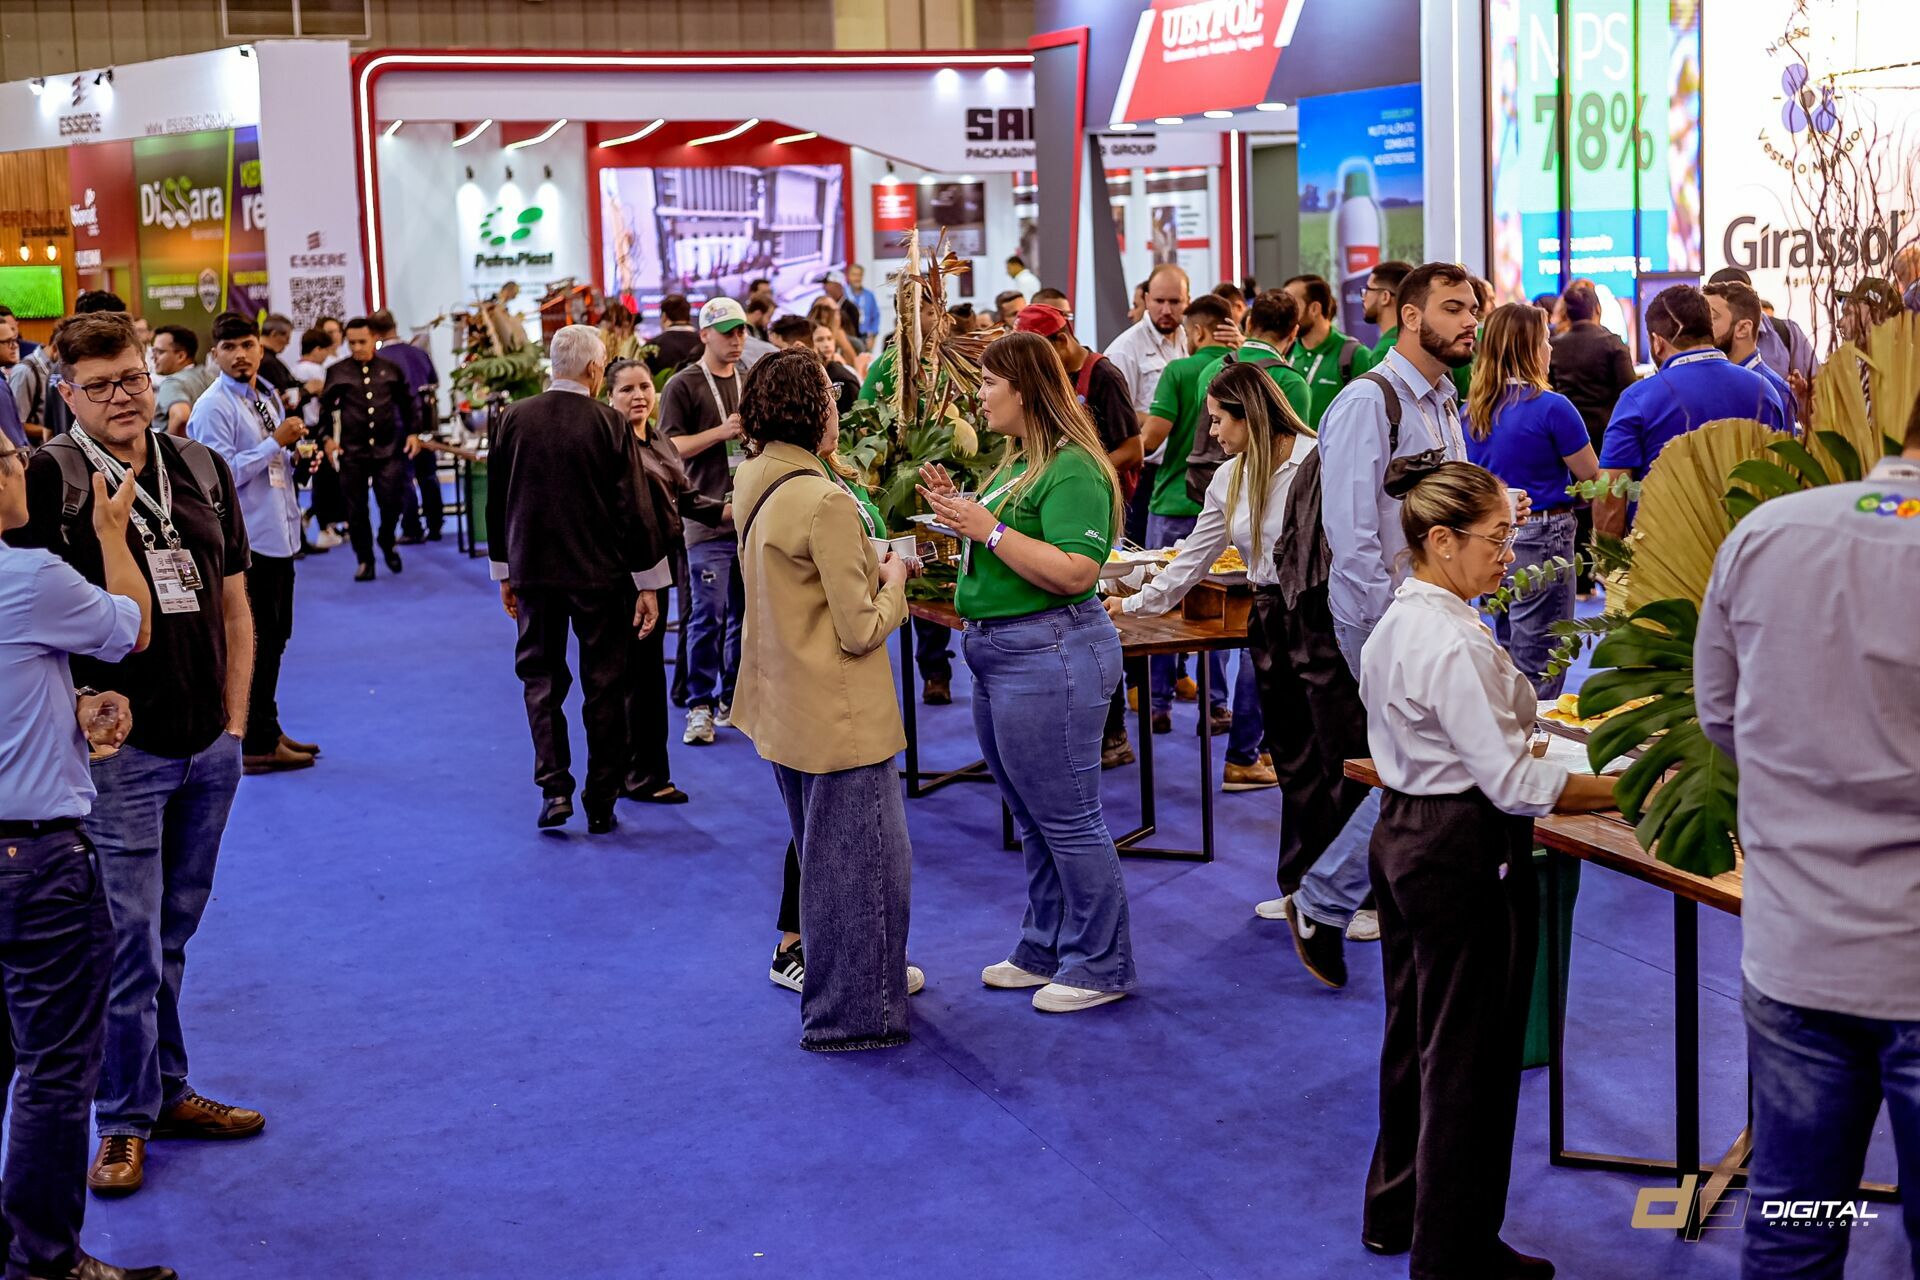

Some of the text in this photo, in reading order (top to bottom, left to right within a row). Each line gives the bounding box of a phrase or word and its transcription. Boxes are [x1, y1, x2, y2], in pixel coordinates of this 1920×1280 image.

[1530, 12, 1630, 82] NPS
[966, 147, 1035, 158] PACKAGIN
[1111, 144, 1156, 155] GROUP
[1534, 92, 1654, 171] 78%
[290, 252, 347, 268] ESSERE
[1723, 209, 1899, 272] Girassol
